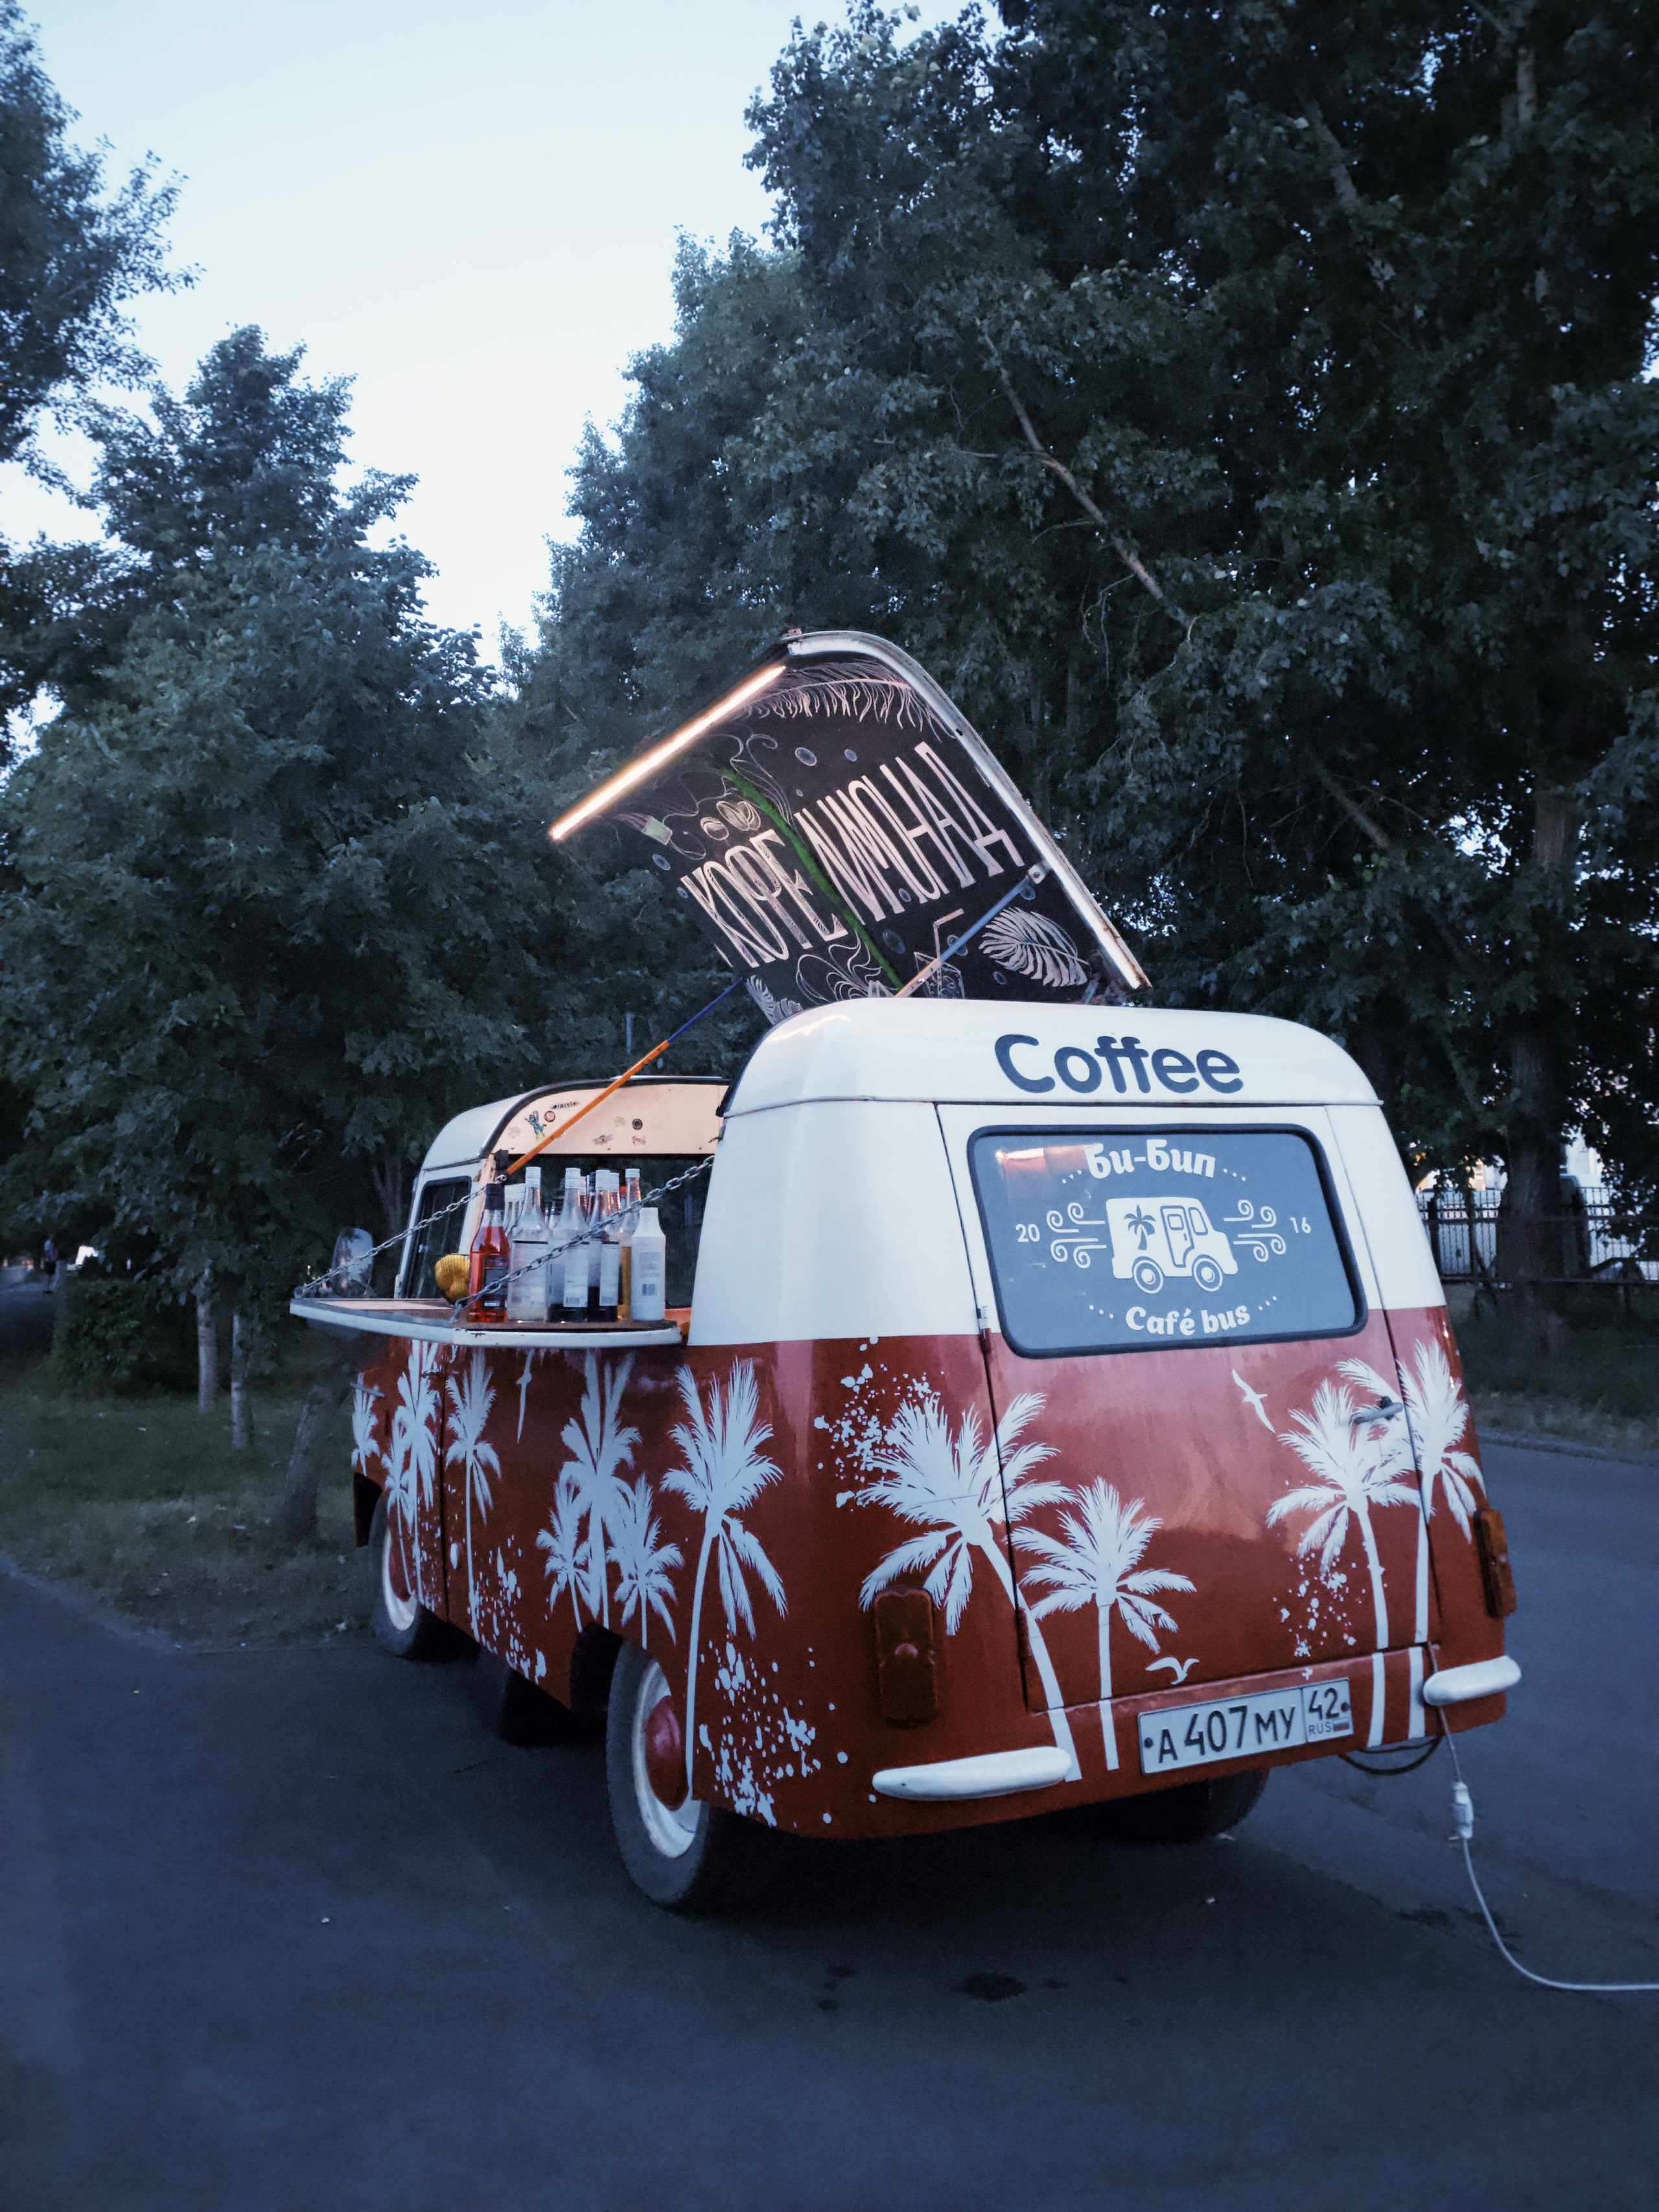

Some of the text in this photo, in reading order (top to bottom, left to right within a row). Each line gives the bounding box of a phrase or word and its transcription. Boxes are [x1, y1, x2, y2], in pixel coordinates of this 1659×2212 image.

[794, 741, 1025, 926] ЛИМОНАД
[680, 829, 848, 968] КОФЕ
[994, 1034, 1244, 1093] Coffee
[1015, 1217, 1312, 1242] 20 16
[1125, 1305, 1250, 1336] Café bus
[1308, 1687, 1340, 1721] 42
[1308, 1718, 1333, 1736] RUS
